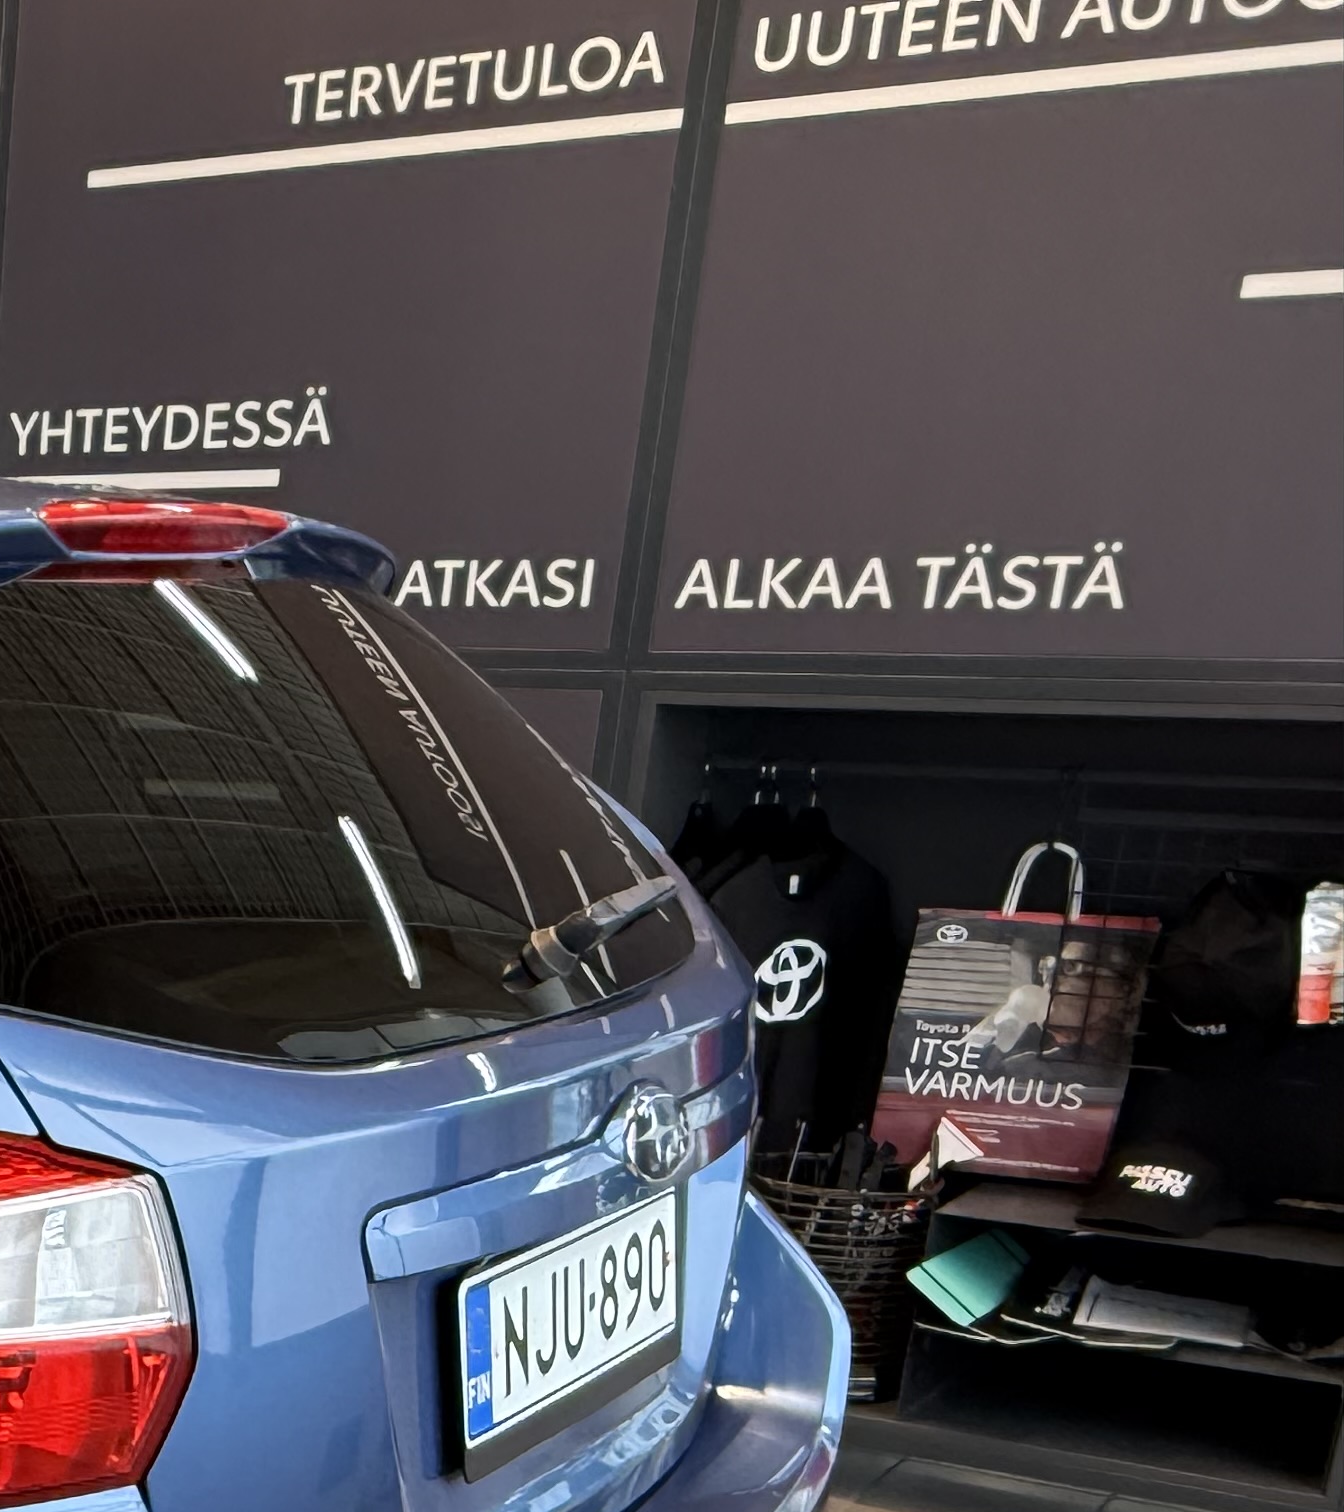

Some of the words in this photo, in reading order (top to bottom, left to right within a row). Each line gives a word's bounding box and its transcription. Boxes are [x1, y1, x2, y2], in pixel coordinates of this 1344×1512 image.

[754, 0, 1041, 73] UUTEEN
[283, 30, 665, 125] TERVETULOA
[9, 385, 332, 457] YHTEYDESSÄ
[674, 556, 893, 610] ALKAA
[915, 541, 1125, 610] TÄSTÄ
[909, 1036, 984, 1070] ITSE
[915, 1018, 960, 1035] Toyota
[904, 1066, 1087, 1111] VARMUUS
[502, 1218, 667, 1398] NJU-890
[467, 1373, 492, 1410] FIN
